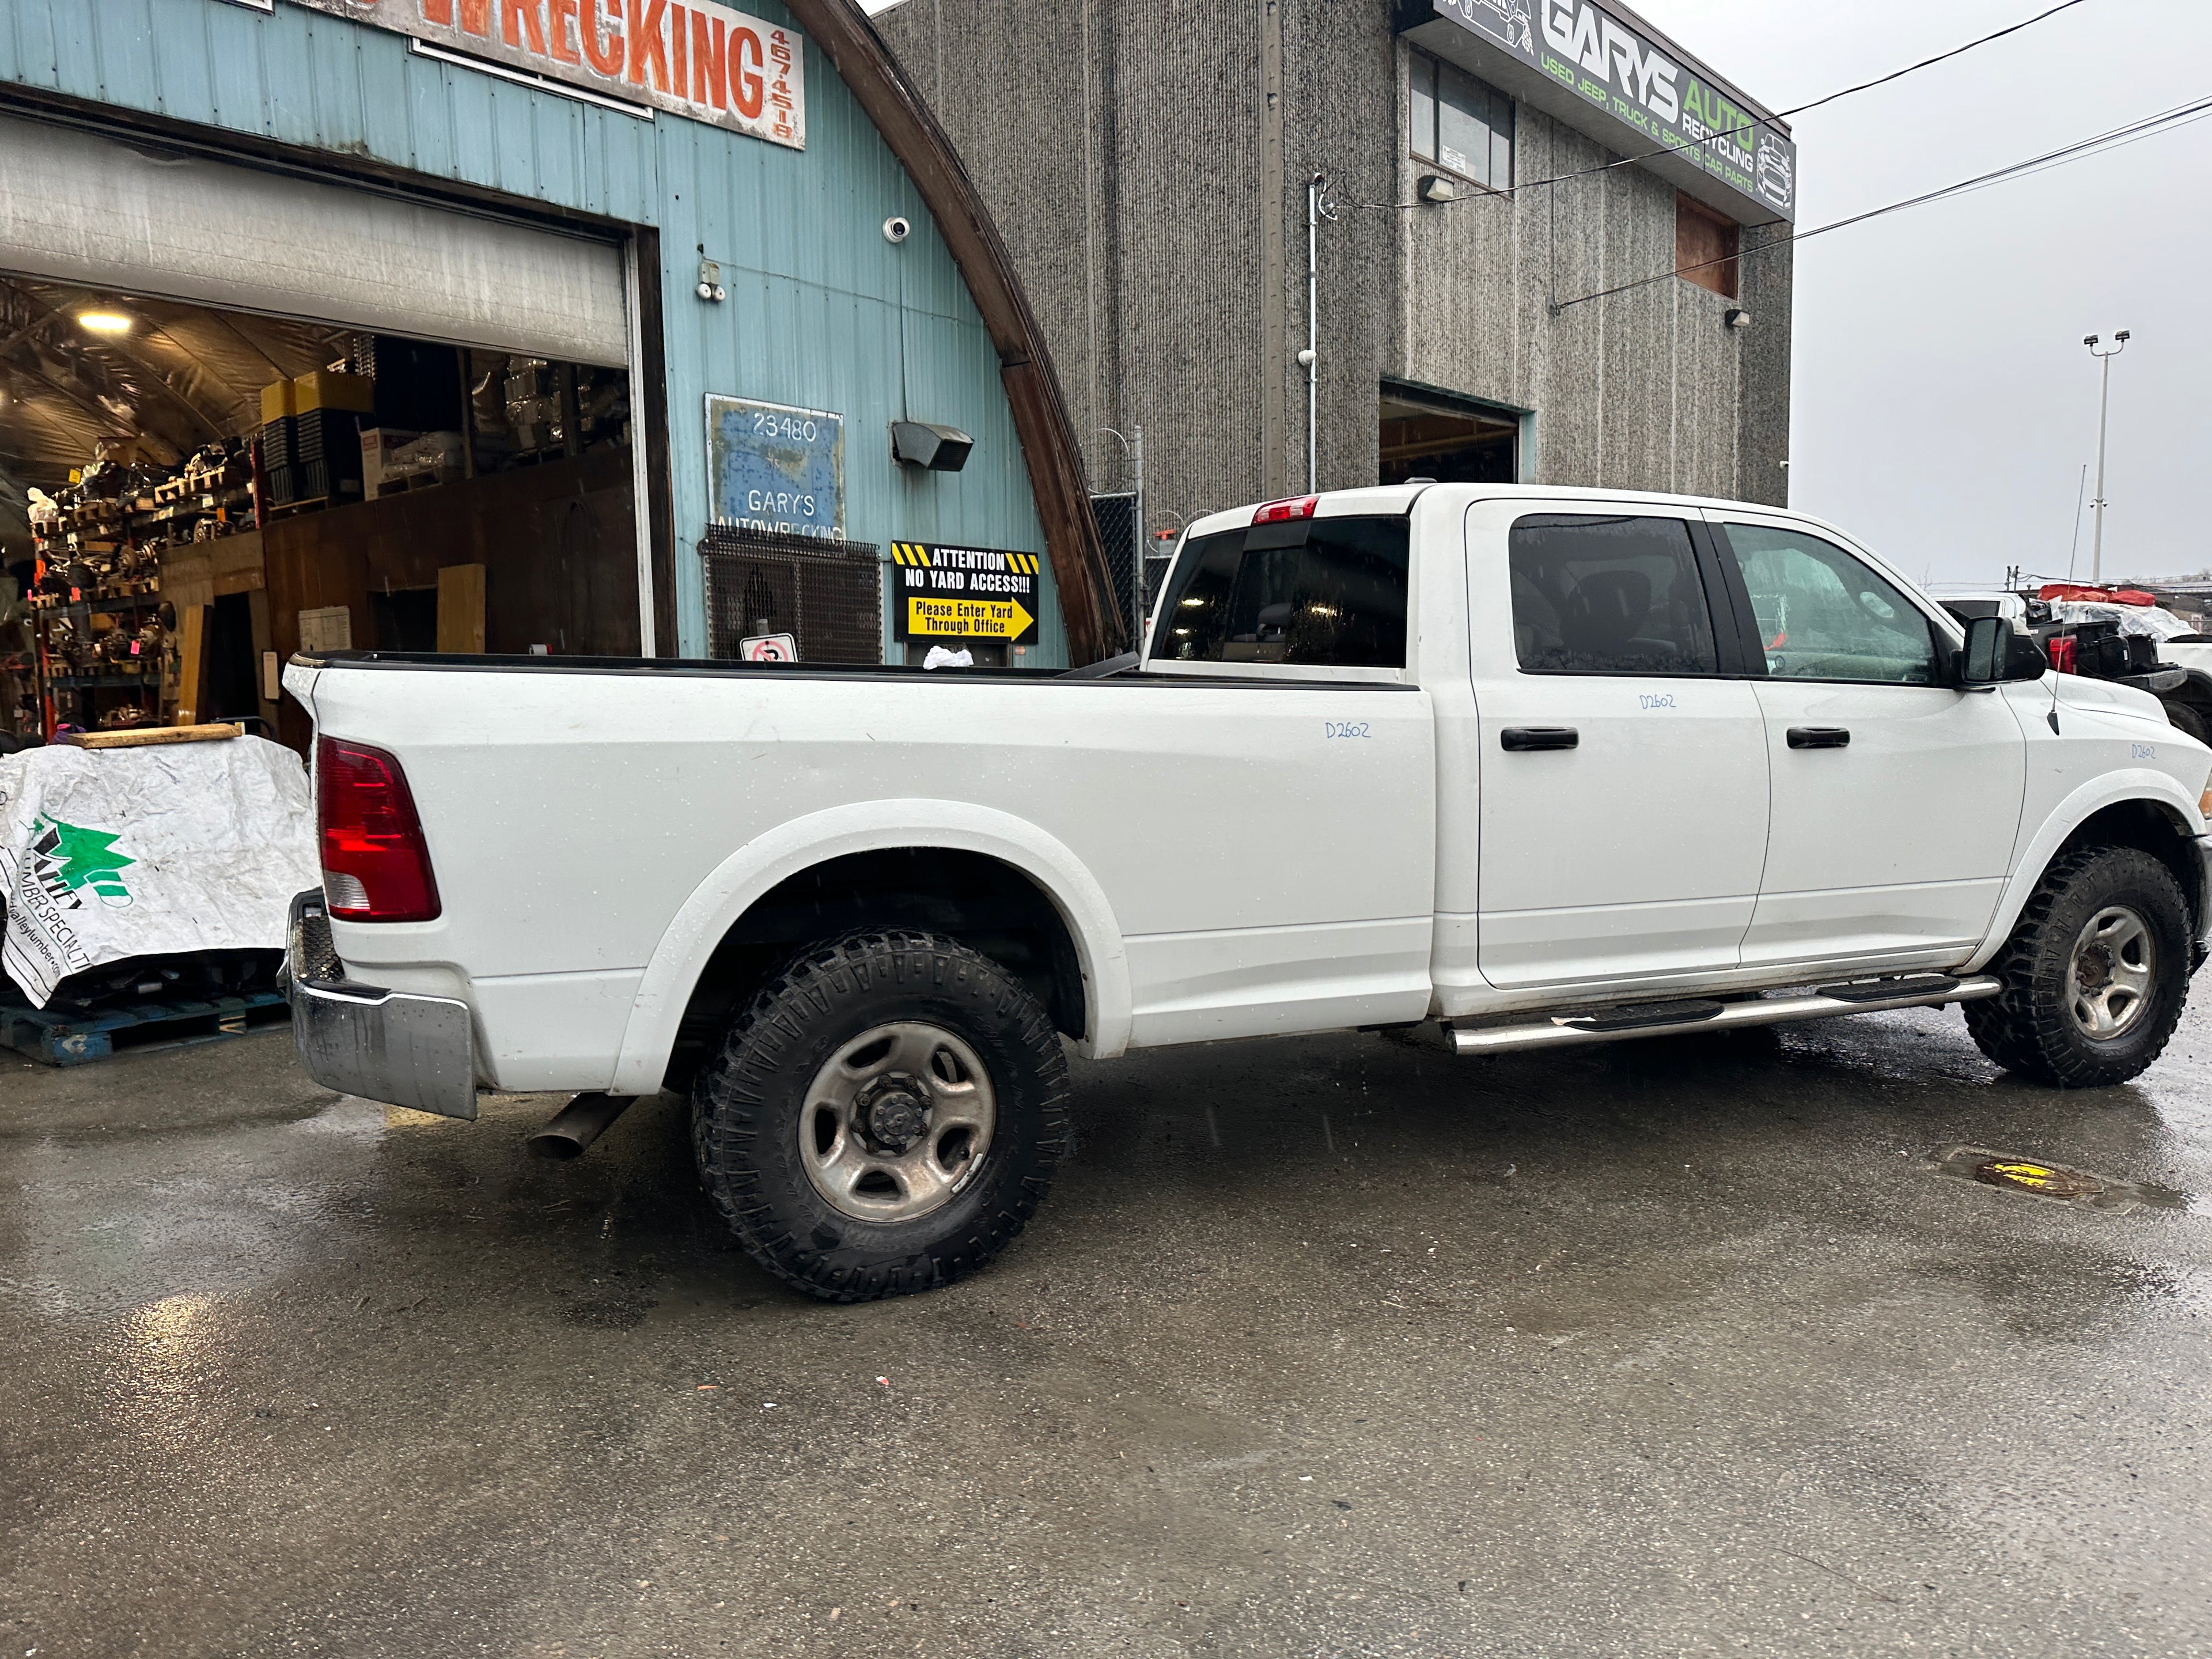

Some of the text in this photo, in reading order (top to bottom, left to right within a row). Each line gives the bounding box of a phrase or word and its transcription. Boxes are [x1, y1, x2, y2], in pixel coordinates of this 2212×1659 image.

[1541, 0, 1753, 152] GARYS AUTO
[1541, 52, 1753, 193] USED JEEP, TRUCK & SPORTS CAR PARTS
[1682, 112, 1753, 173] RECYCLING
[753, 412, 817, 442] 23480
[748, 489, 815, 517] GARY'S
[932, 548, 1005, 571] ATTENTION
[905, 568, 1030, 593] NO YARD ACCESS!!!
[916, 601, 1013, 619] Please Enter Yard
[925, 616, 1005, 634] Through Office
[1639, 694, 1677, 710] D2602
[1325, 722, 1372, 738] D2602
[2131, 744, 2156, 759] D2602
